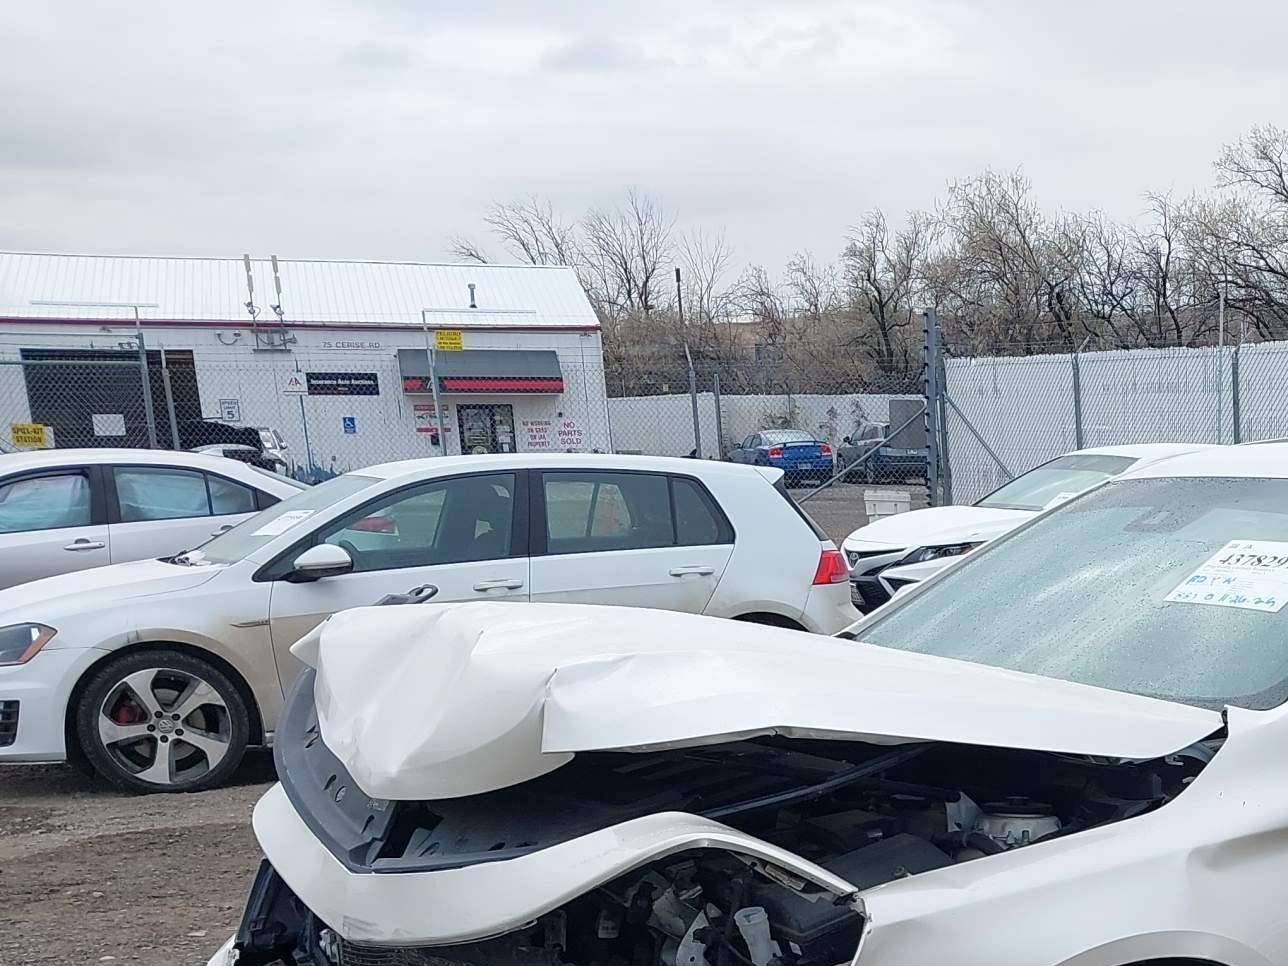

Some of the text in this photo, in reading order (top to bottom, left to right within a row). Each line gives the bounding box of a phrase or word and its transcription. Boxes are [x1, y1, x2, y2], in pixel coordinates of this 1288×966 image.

[336, 341, 364, 349] CERISE
[368, 341, 381, 349] RD
[226, 410, 235, 419] 5
[563, 421, 575, 429] NO
[558, 429, 583, 437] PARTS
[560, 437, 582, 445] SOLD
